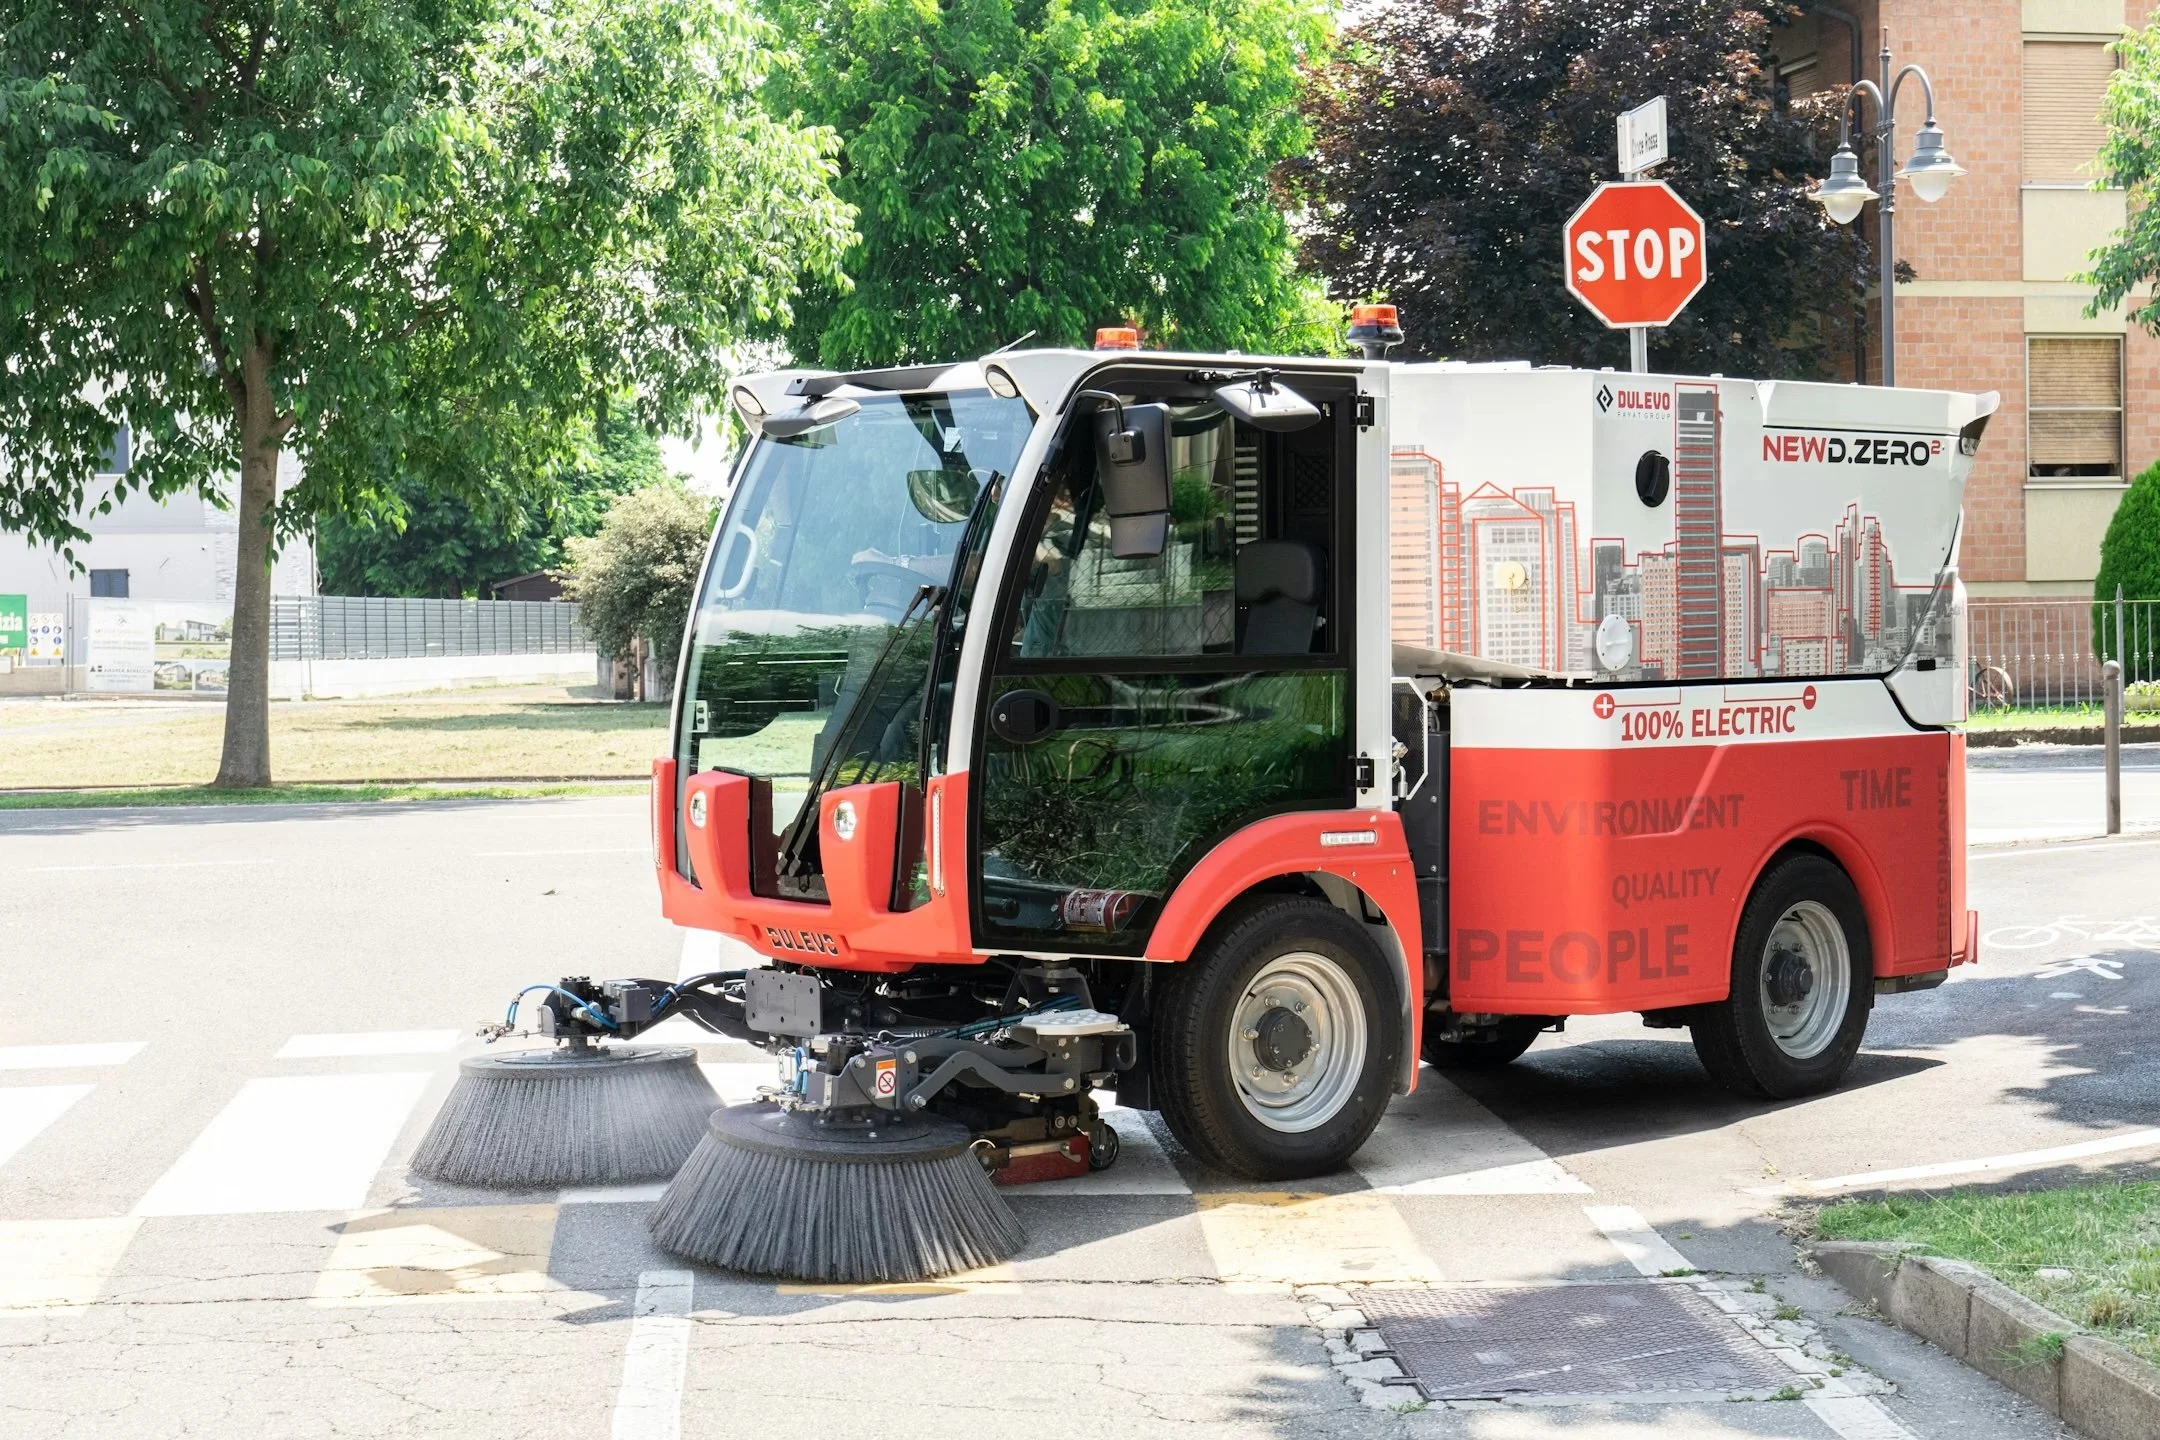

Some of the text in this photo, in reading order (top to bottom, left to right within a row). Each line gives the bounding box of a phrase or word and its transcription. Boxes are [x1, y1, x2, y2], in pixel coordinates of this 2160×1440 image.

[1576, 227, 1695, 282] STOP
[1617, 390, 1670, 410] DULEVO
[1644, 412, 1671, 420] GROUP
[1621, 705, 1796, 741] 100% ELECTRIC
[1840, 766, 1912, 811] TIME
[1478, 794, 1744, 837] ENVIRONMENT
[1936, 763, 1949, 959] PERFORMANCE
[1611, 867, 1721, 909] QUALITY
[766, 927, 838, 956] DULEVO
[1456, 924, 1689, 984] PEOPLE
